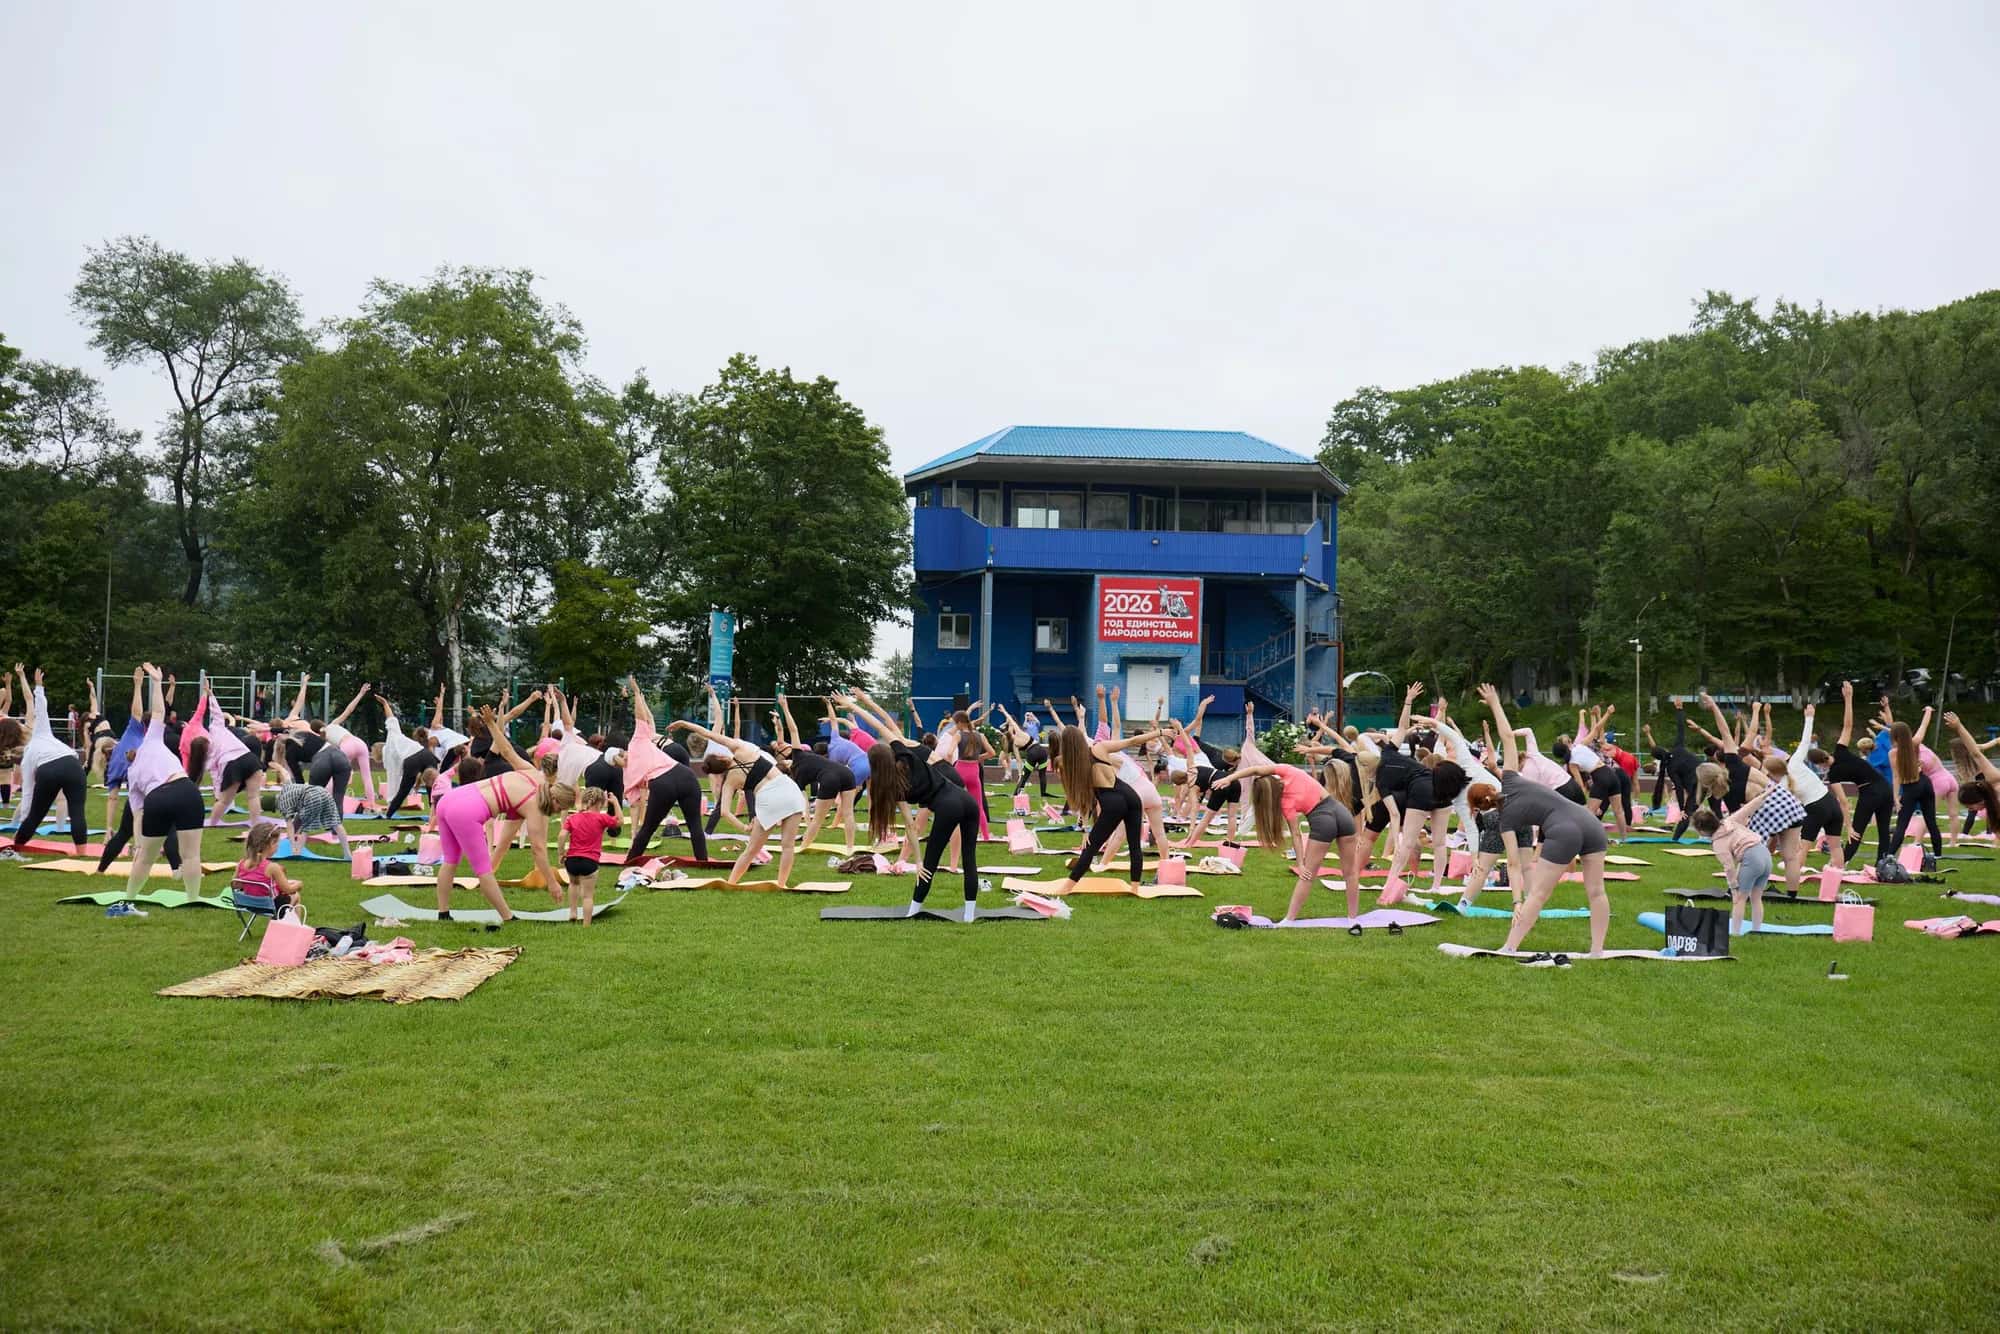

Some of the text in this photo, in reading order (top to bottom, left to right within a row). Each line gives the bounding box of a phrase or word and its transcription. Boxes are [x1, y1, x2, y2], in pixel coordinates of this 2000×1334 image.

[1103, 594, 1153, 613] 2026
[1103, 619, 1178, 629] ГОД ЕДИНСТВА
[1103, 629, 1193, 639] НАРОДОВ РОССИИ
